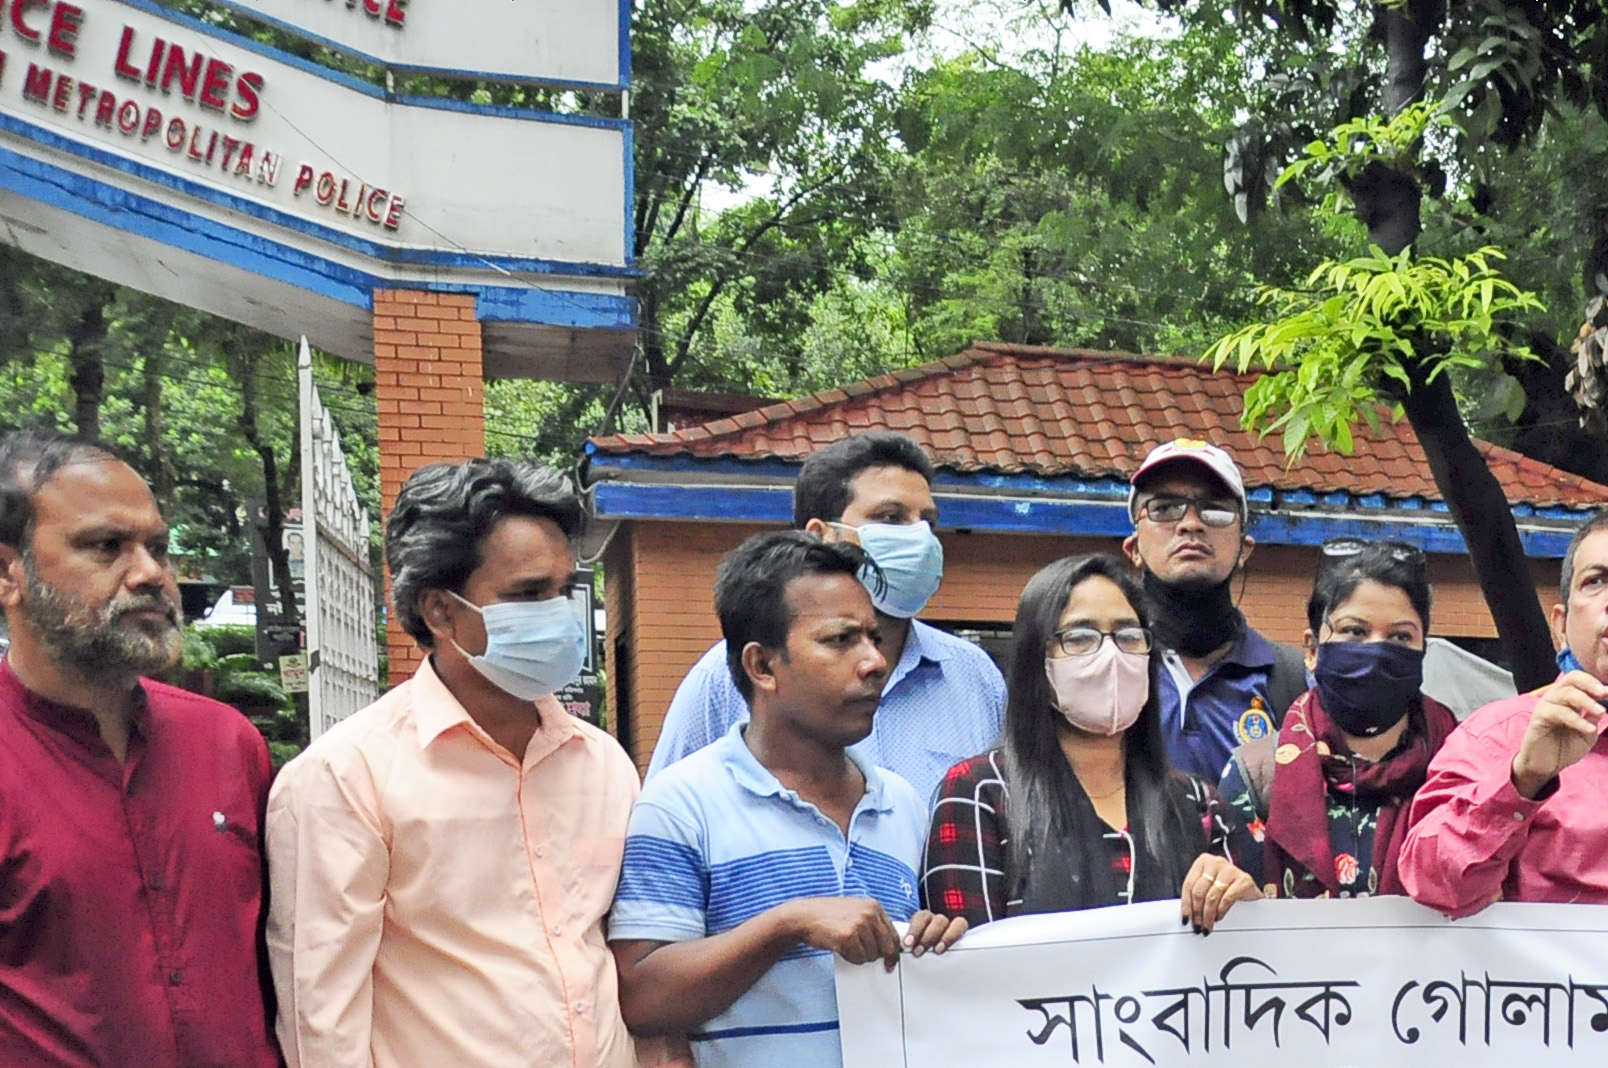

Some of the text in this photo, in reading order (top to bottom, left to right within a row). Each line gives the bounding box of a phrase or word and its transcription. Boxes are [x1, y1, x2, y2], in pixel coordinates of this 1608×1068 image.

[0, 0, 267, 122] CE LINES
[23, 62, 281, 187] METROPOLITAN
[293, 163, 405, 230] POLICE
[1016, 956, 1360, 1065] সাংবাদিক
